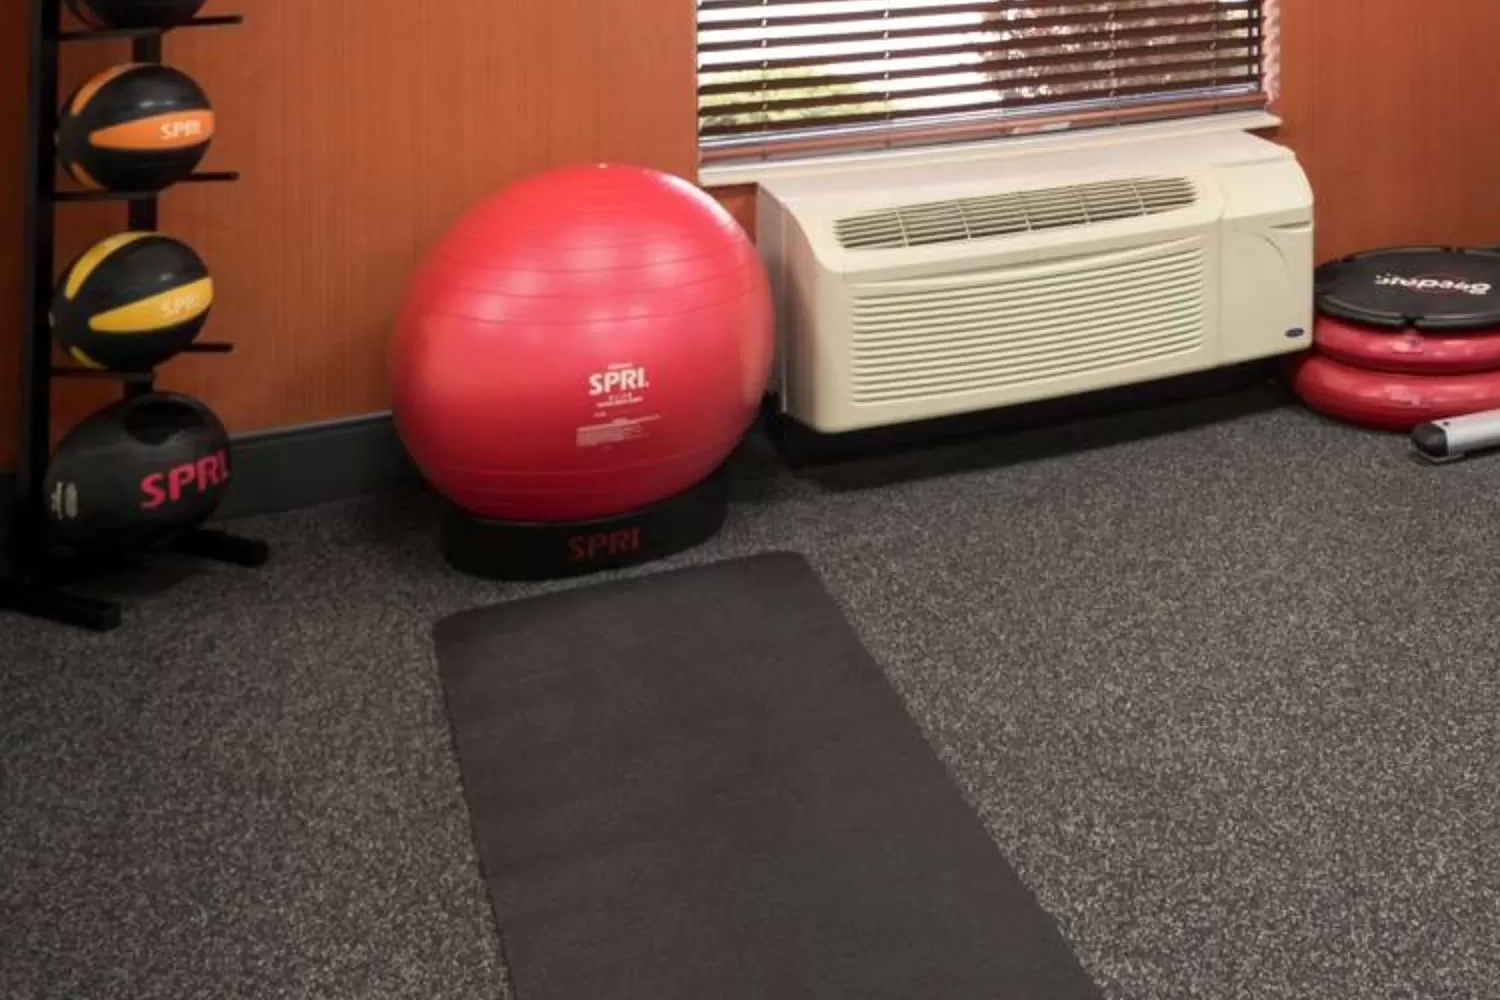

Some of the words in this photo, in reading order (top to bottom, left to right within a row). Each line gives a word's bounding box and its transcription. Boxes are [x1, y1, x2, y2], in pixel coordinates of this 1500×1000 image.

[588, 366, 645, 396] SPRI
[141, 451, 228, 509] SPRI
[567, 527, 641, 561] SPRI
